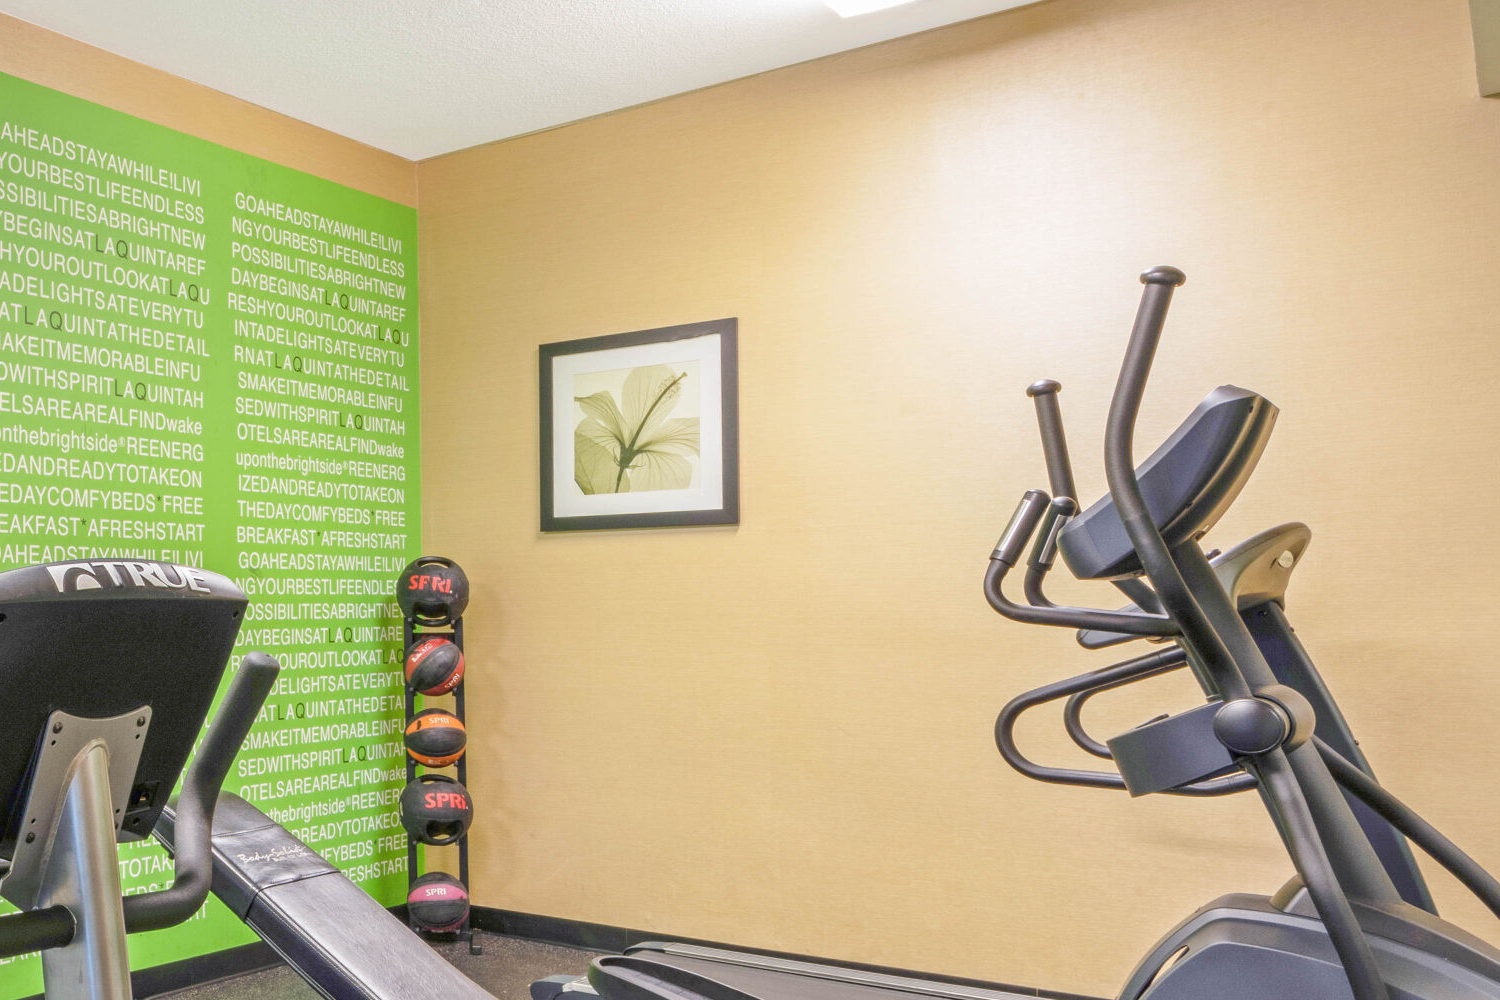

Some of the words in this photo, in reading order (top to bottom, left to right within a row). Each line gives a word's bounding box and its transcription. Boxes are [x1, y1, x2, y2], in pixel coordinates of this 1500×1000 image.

[91, 561, 211, 594] TRUE
[244, 602, 404, 621] OSSIBILITIESABRIGHTNE
[253, 696, 406, 722] ATLAQUINTATHEDETAI
[425, 887, 447, 897] SPRI
